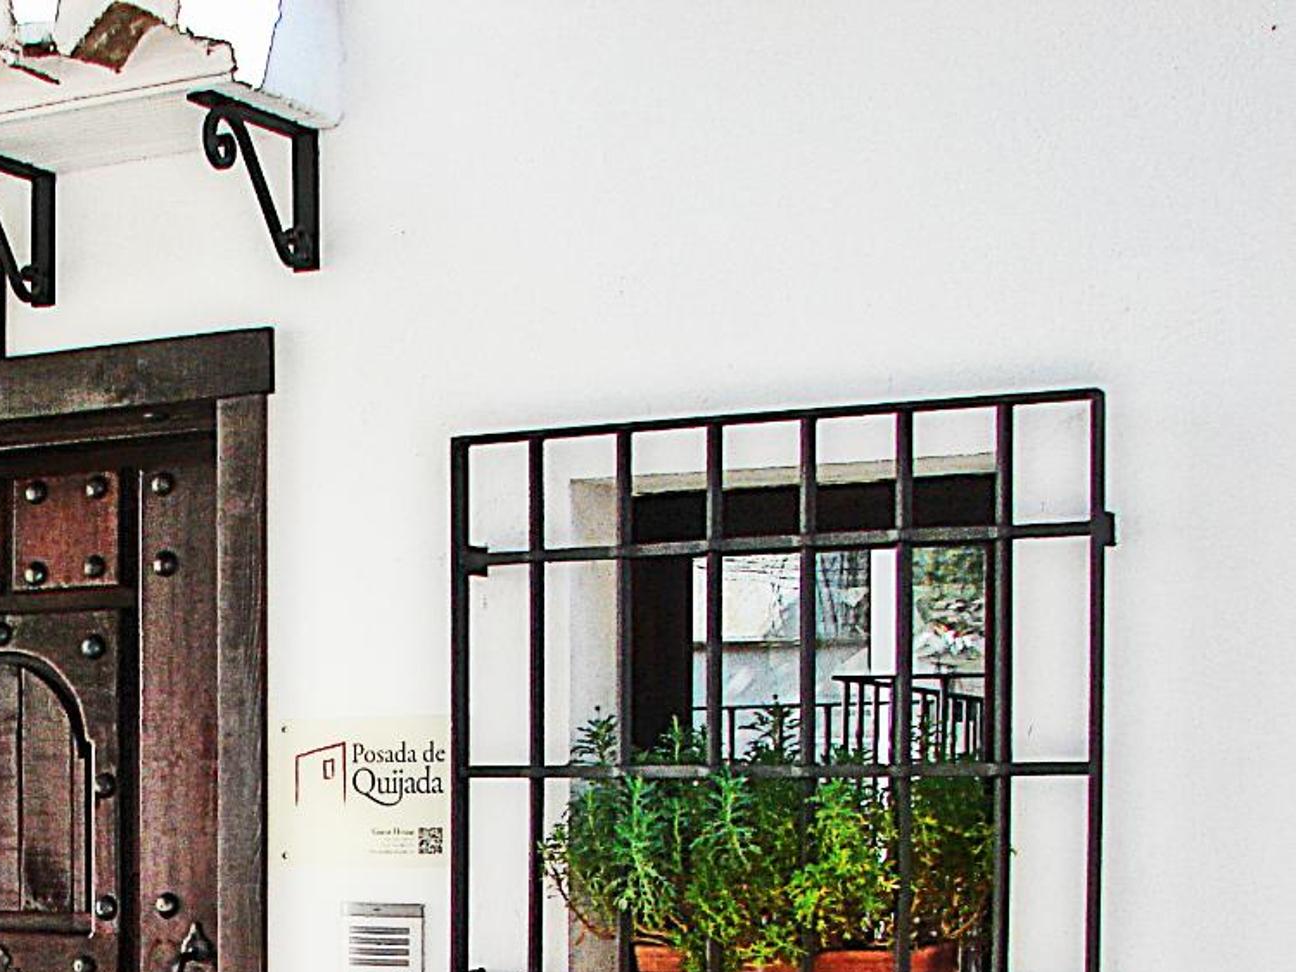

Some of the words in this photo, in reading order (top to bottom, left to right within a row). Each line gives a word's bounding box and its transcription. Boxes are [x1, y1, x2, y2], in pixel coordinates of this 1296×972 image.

[352, 741, 417, 764] Posada
[423, 740, 446, 763] de
[352, 765, 444, 807] Quijada
